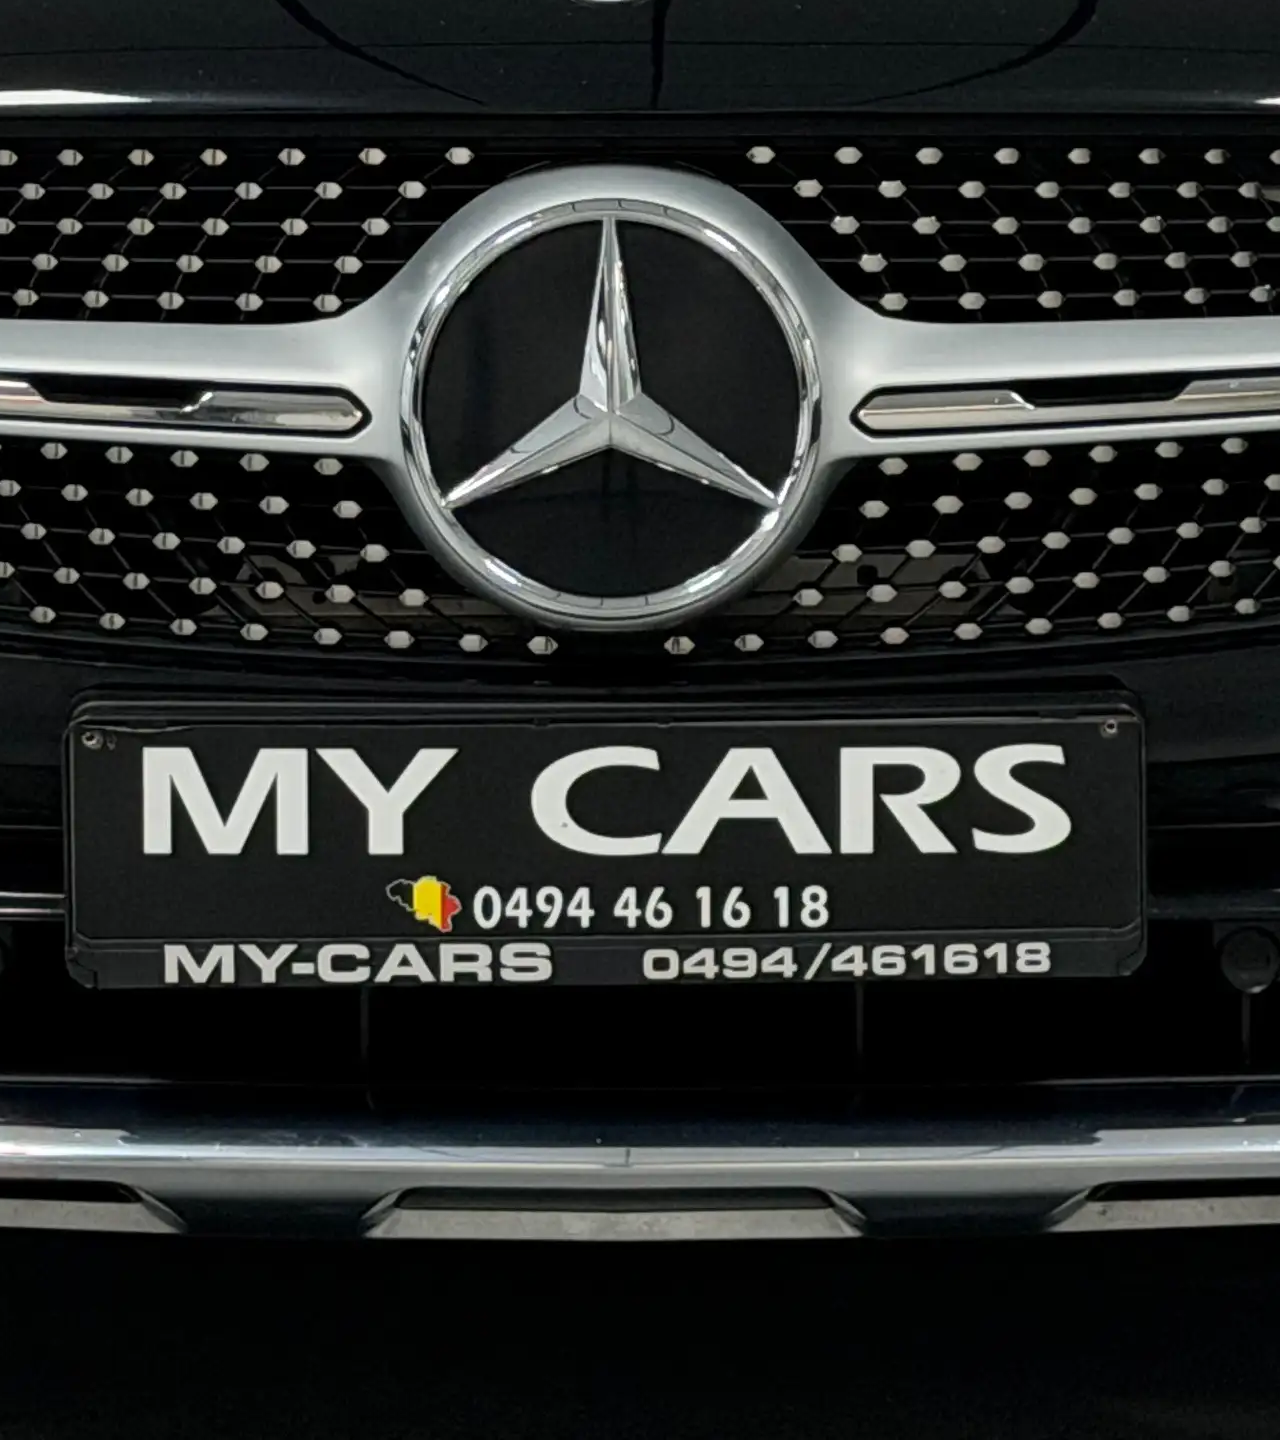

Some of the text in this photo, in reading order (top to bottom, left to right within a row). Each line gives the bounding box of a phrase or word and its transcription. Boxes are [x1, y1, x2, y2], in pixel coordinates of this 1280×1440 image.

[142, 743, 1072, 857] MY CARS
[473, 885, 829, 929] 0494 46 16 18
[163, 941, 1051, 984] MY-CARS 0494/461618
